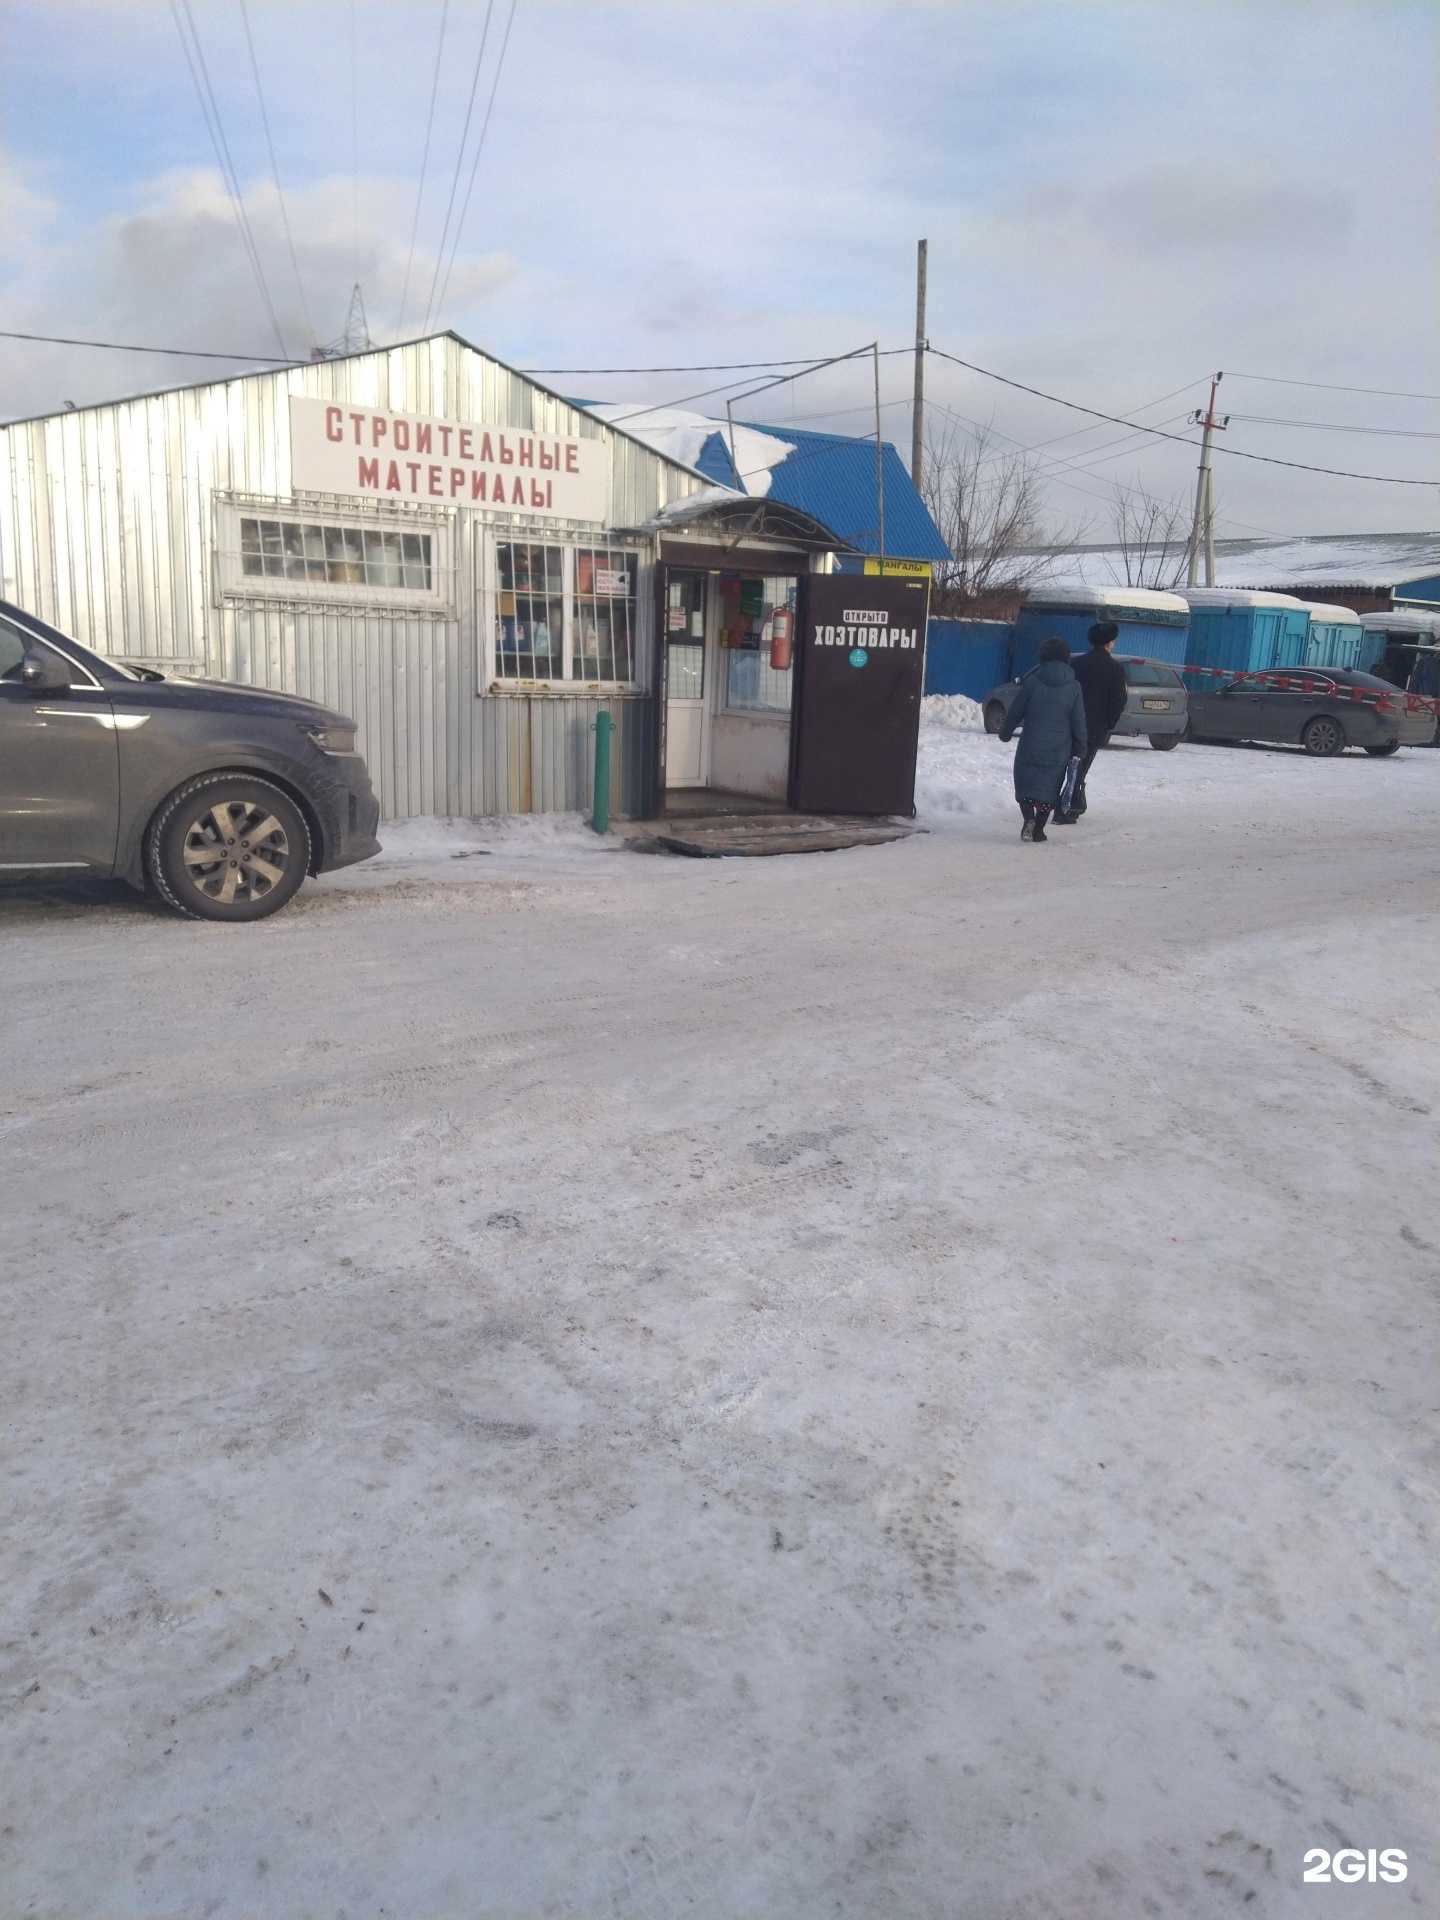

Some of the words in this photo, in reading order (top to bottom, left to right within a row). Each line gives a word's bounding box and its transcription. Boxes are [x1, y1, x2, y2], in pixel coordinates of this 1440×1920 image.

[326, 406, 580, 474] СТРОИТЕЛЬНЫЕ
[357, 456, 553, 508] МАТЕРИАЛЫ
[845, 611, 887, 623] ОТКРЫТО
[814, 625, 917, 649] ХОЗТОВАРЫ
